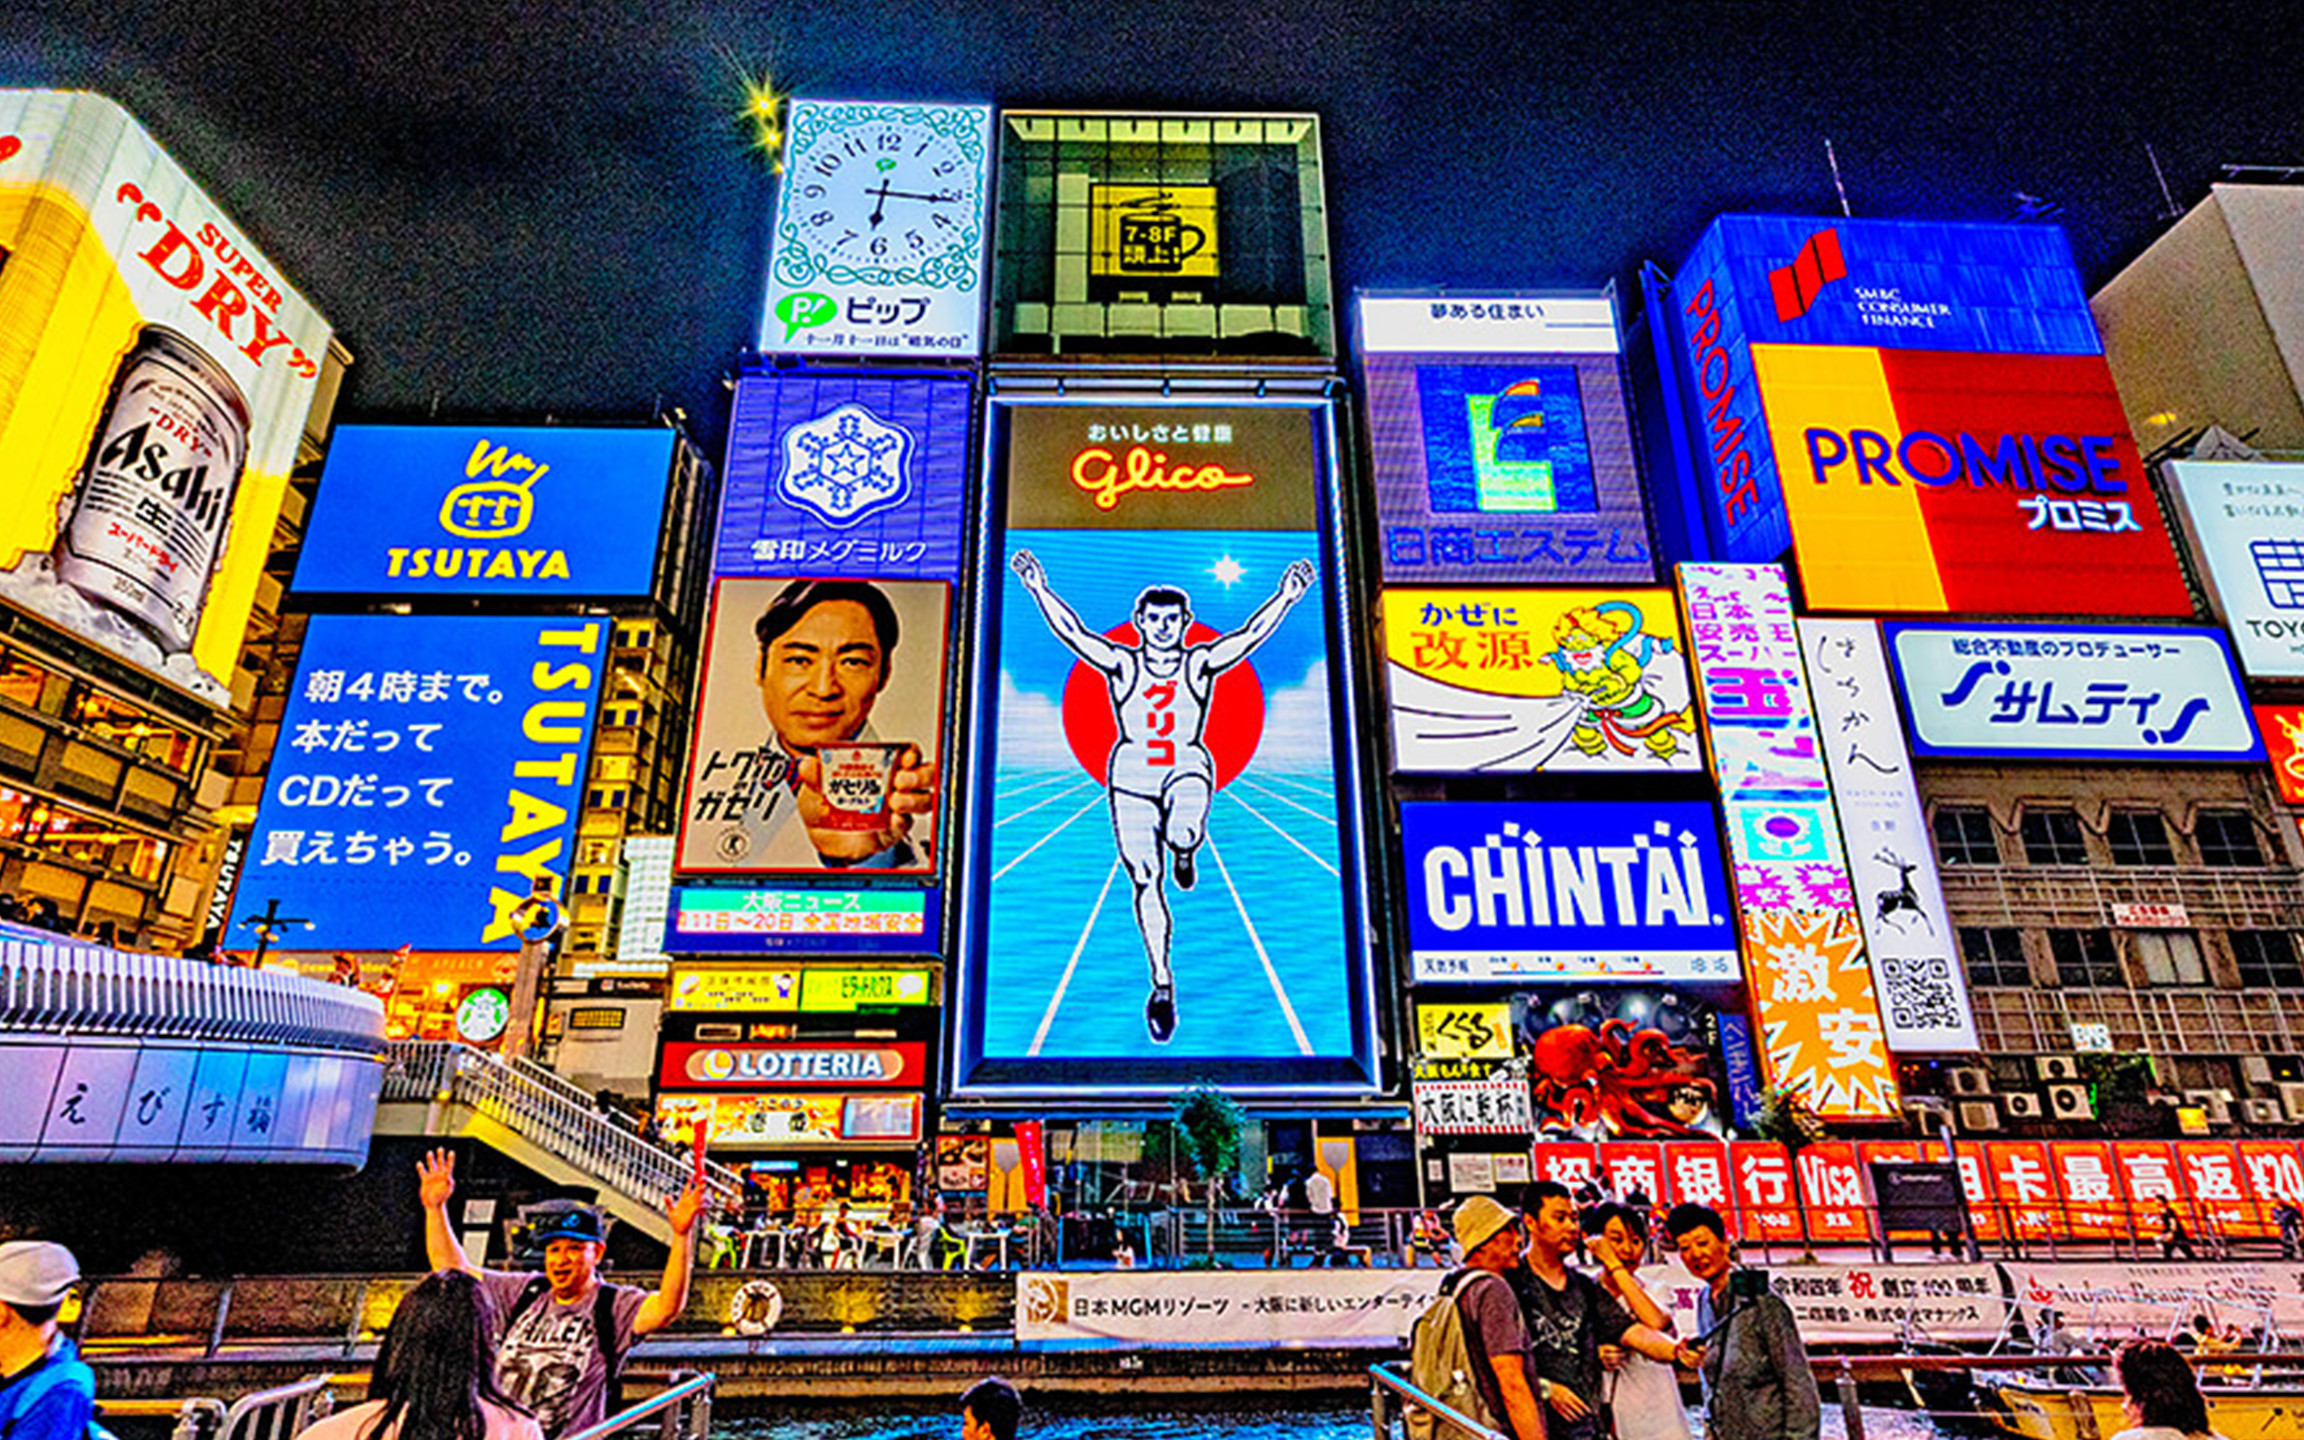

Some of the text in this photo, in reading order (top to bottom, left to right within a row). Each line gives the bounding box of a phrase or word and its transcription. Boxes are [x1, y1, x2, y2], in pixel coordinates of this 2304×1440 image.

[1124, 226, 1177, 242] 7-8F
[197, 222, 283, 313] SUPER
[846, 296, 932, 325] ピップ
[1685, 279, 1758, 526] PROMISE
[1088, 424, 1232, 442] おいしさと健康
[100, 421, 224, 532] Asahi
[1803, 427, 2128, 492] PROMISE
[2017, 494, 2142, 532] プロミス
[386, 547, 571, 580] TSUTAYA
[751, 539, 927, 562] 雪印メグミルク
[1387, 524, 1651, 566] 日商エステム
[1420, 602, 1518, 627] かぜに
[1410, 630, 1534, 671] 改源
[291, 721, 444, 755] 本だって
[1142, 680, 1178, 766] グリコ
[277, 775, 453, 807] CDだって
[481, 622, 600, 944] TSUTAYA
[261, 830, 473, 867] 買えちゃう。
[205, 839, 243, 929] TSUTAYA
[743, 890, 861, 911] 大阪ニュース
[1766, 943, 1883, 1068] 激安
[739, 1051, 884, 1077] LOTTERIA
[1798, 1155, 1863, 1206] Visa
[1847, 1270, 1877, 1299] 祝
[1074, 1298, 1229, 1318] 日本MGMリゾーツ
